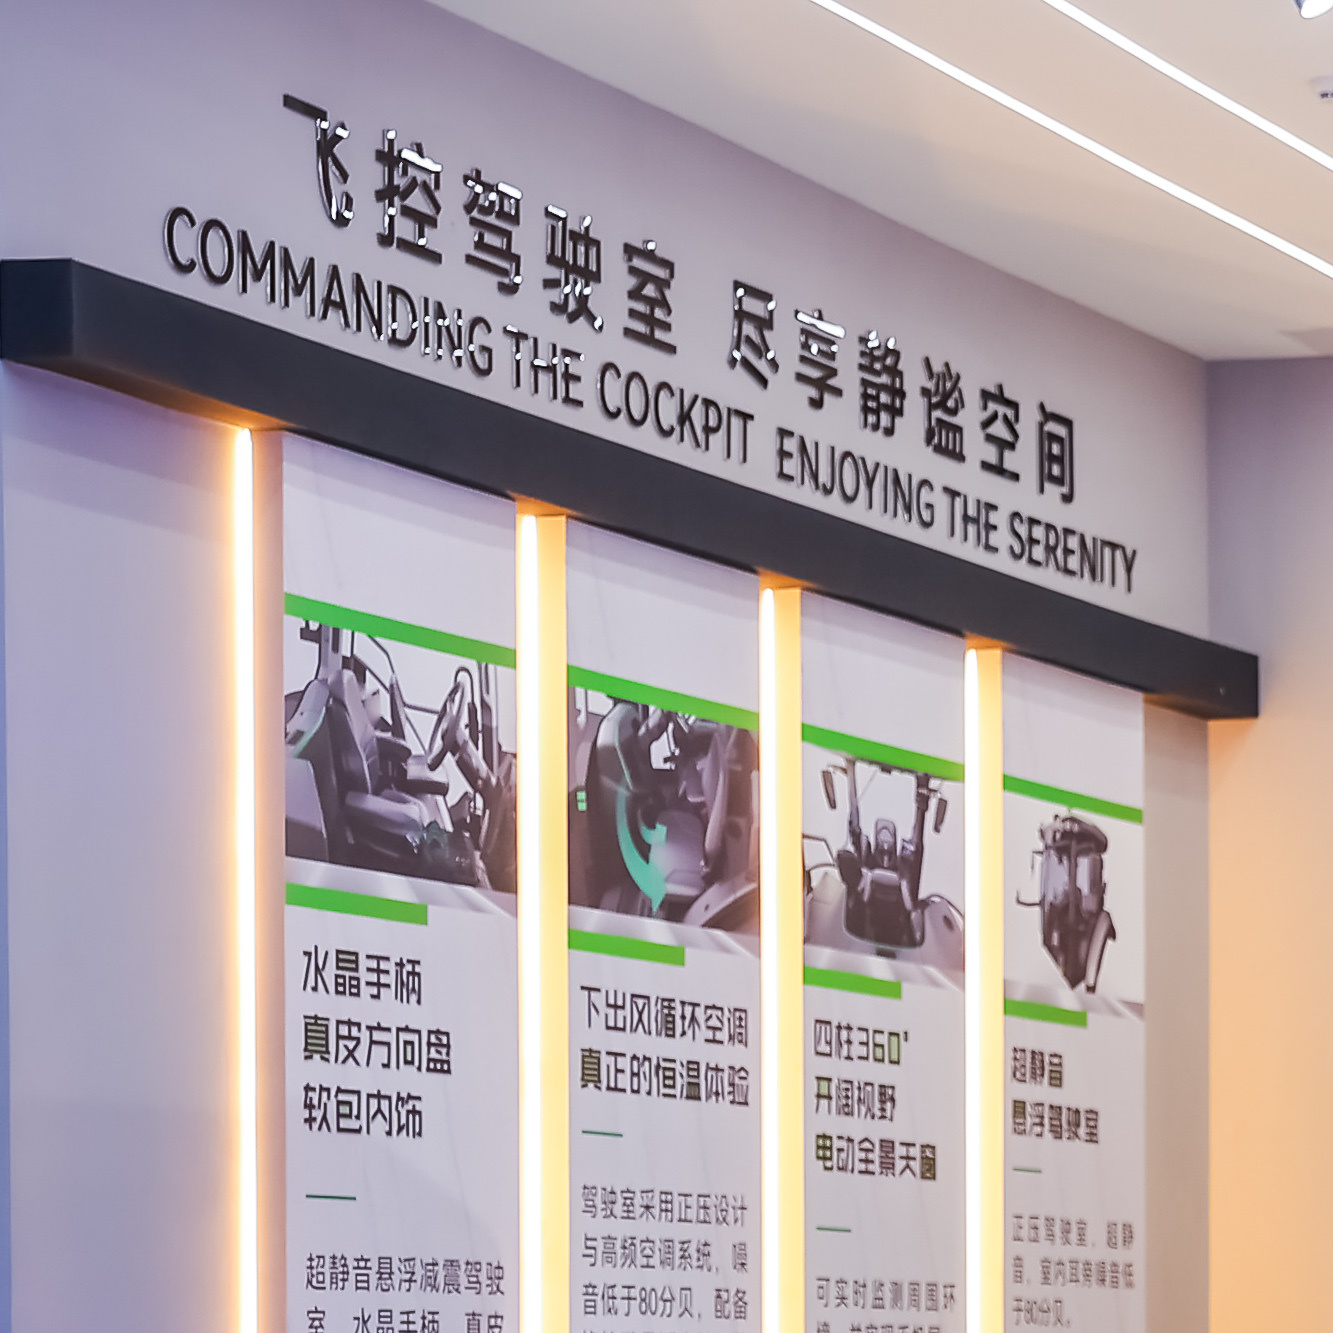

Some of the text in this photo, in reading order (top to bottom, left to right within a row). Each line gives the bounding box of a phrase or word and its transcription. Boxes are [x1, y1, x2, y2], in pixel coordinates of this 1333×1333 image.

[283, 93, 1076, 505] 飞控驾驶室 尽享静谧空间
[162, 206, 1137, 594] COMMANDING THE COCKPIT ENJOYING THE SERENITY
[302, 945, 422, 1006] 水晶手柄
[580, 986, 748, 1048] 下出风循环空调
[303, 1014, 452, 1075] 真皮方向盘
[1012, 1047, 1063, 1088] 超静音
[580, 1048, 749, 1106] 真正的恒温体验
[815, 1076, 896, 1122] 开阔视野
[303, 1083, 423, 1139] 软包内饰
[1012, 1100, 1099, 1144] 悬浮驾驶室
[816, 1132, 937, 1181] 电动全景天窗
[582, 1184, 748, 1227] 驾驶室采用正压设计
[306, 1253, 505, 1296] 超静音悬浮减震驾驶
[816, 1277, 956, 1312] 可实时监测周围环
